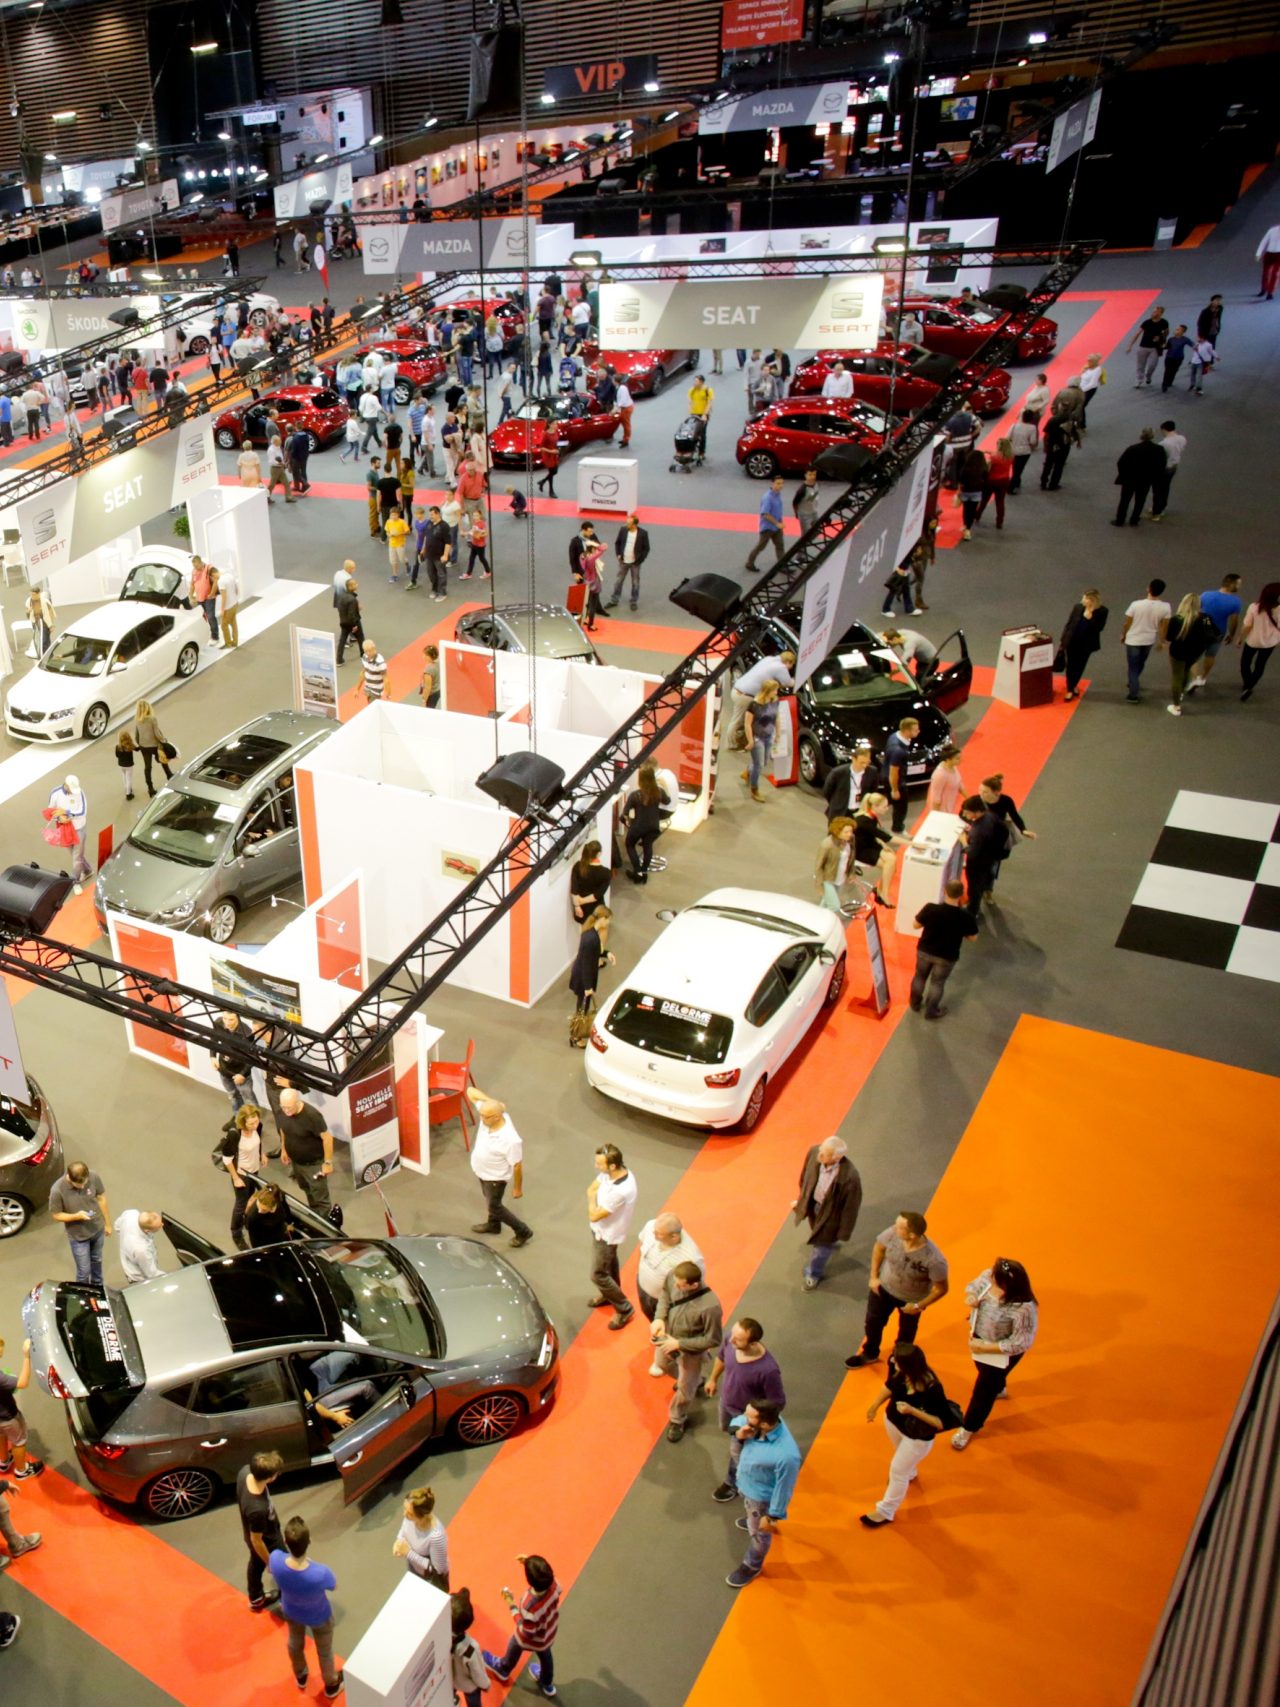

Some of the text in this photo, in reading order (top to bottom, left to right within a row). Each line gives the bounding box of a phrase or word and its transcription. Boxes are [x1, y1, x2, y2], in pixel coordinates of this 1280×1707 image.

[574, 61, 626, 93] VIP
[752, 102, 794, 117] MAZDA
[422, 239, 473, 255] MAZDA
[66, 313, 110, 331] ŠKODA
[701, 305, 761, 326] SEAT
[604, 326, 649, 335] SEAT
[818, 324, 872, 334] SEAT
[181, 462, 214, 485] SEAT
[102, 474, 145, 514] SEAT
[30, 538, 67, 566] SEAT
[857, 528, 889, 584] SEAT
[800, 623, 831, 664] SEAT
[661, 1000, 713, 1022] DELORME
[355, 1100, 374, 1114] SEAT
[374, 1091, 394, 1106] IBIZA
[356, 1085, 393, 1107] NOUVELLE
[101, 1315, 123, 1361] DELORME
